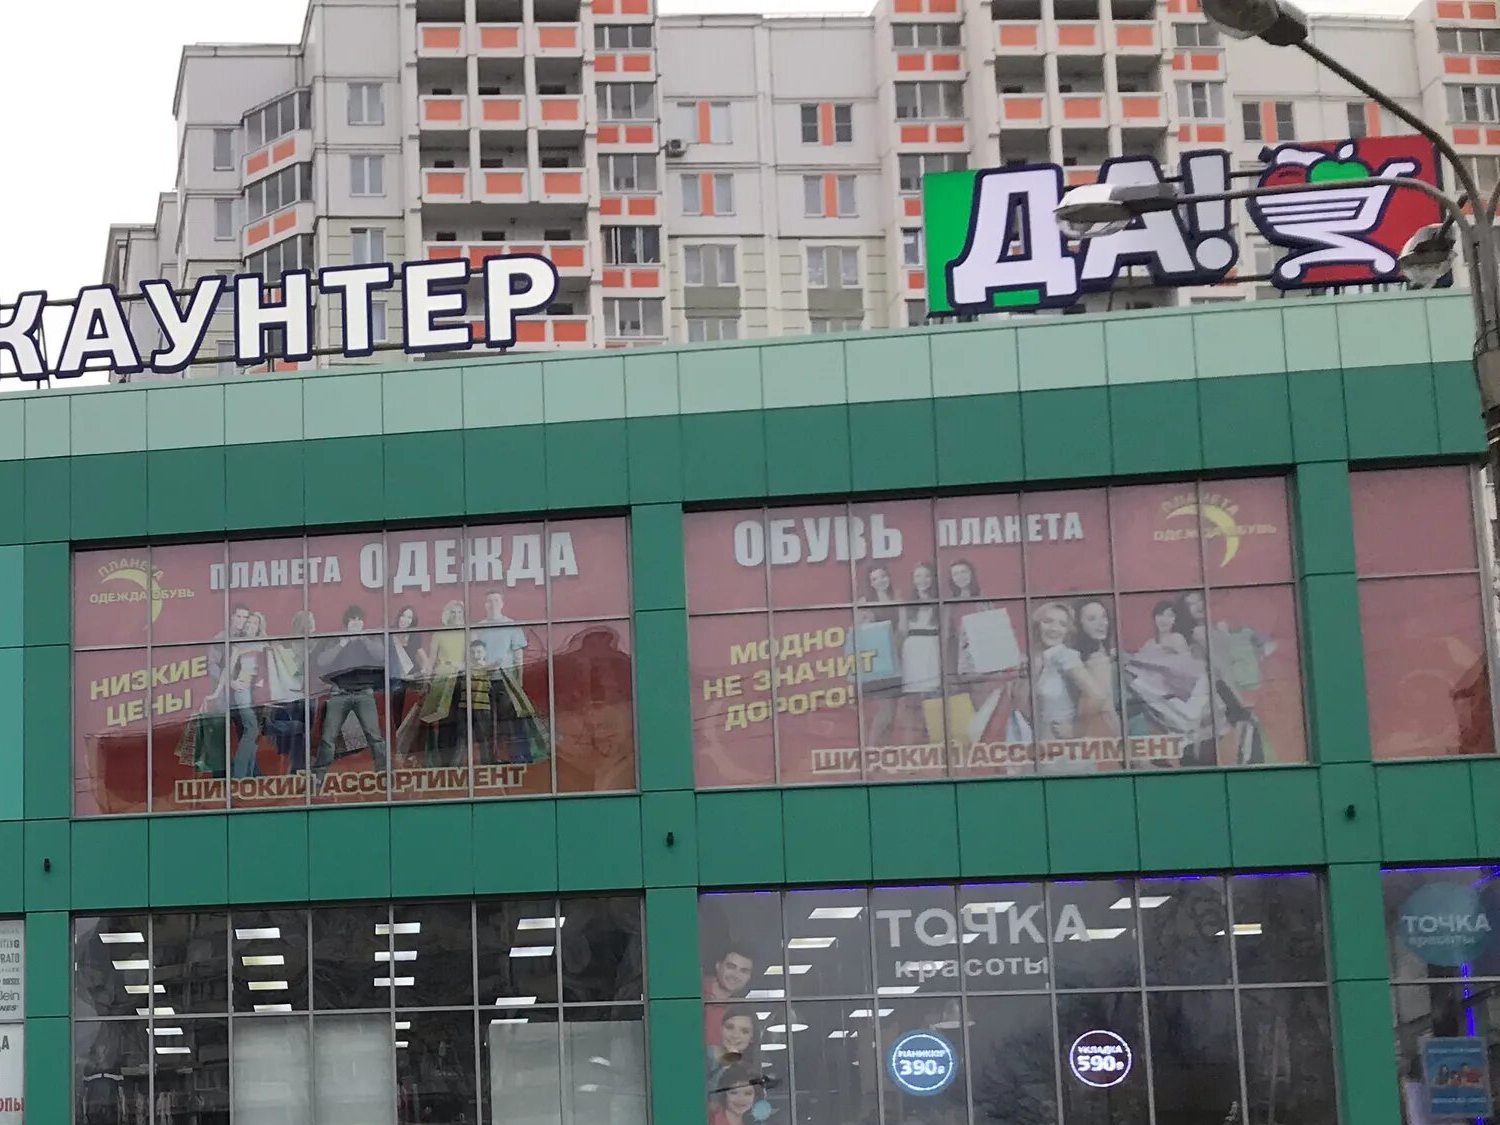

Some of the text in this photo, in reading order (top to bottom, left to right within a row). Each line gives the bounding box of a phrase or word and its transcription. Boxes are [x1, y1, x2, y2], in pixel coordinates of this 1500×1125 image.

[946, 149, 1238, 311] ДА!
[734, 511, 1084, 567] ОБУВЬ ПЛАНЕТА
[210, 532, 579, 594] ПЛАНЕТА ОДЕЖДА
[89, 590, 147, 605] ОДЕЖДА
[729, 626, 846, 666] МОДНО
[90, 655, 208, 700] НИЗКИЕ
[703, 650, 877, 701] НЕ ЗНАЧИТ
[106, 688, 192, 727] ЦЕНЫ
[724, 684, 856, 732] ДОРОГО!
[811, 734, 1185, 774] ШИРОКИЙ АССОРТИМЕНТ
[175, 764, 527, 803] ШИРОКИЙ АССОРТИМЕНТ
[875, 903, 1091, 948] ТОЧКА
[1402, 912, 1492, 933] ТОЧКА
[895, 957, 1049, 983] красоты
